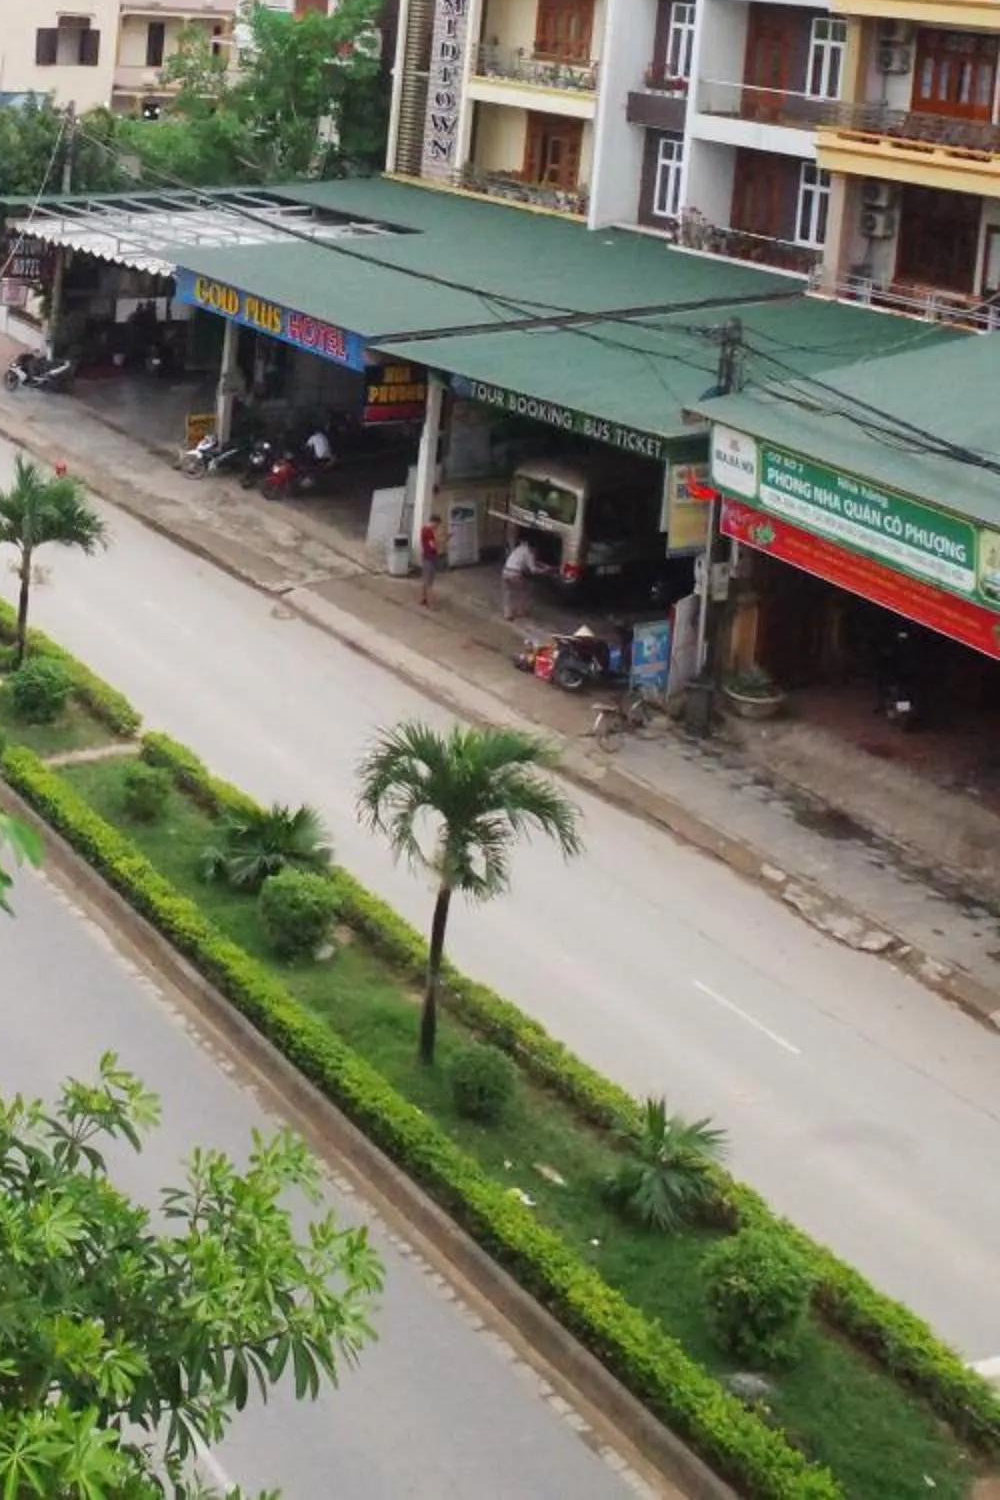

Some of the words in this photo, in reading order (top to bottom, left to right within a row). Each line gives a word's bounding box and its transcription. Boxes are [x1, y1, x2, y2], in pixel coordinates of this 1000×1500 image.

[196, 276, 239, 315] GOLD
[245, 298, 282, 334] PLUS
[289, 312, 346, 360] HOTEL
[470, 381, 505, 408] TOUR
[509, 393, 574, 430] BOOKING
[583, 419, 611, 441] BUS
[616, 428, 663, 459] TICKET
[767, 467, 812, 499] PHONG
[814, 486, 842, 511] NHA
[883, 515, 903, 535] CÔ
[905, 523, 967, 563] PHƯỢNG
